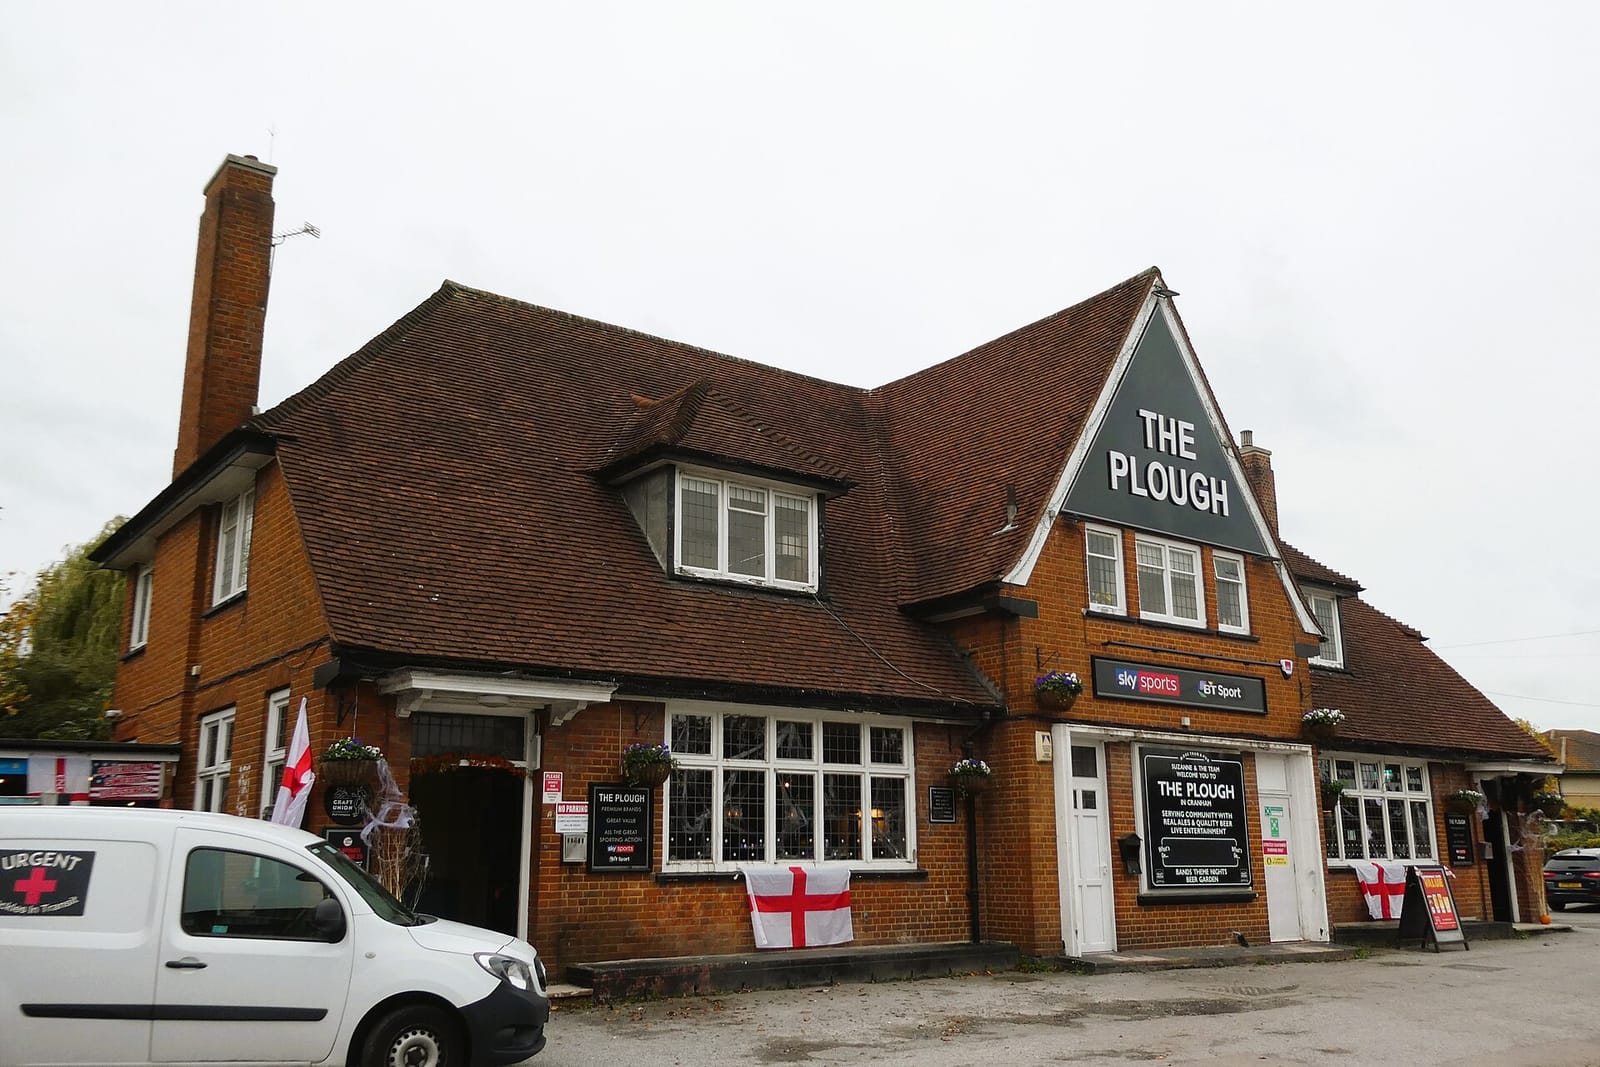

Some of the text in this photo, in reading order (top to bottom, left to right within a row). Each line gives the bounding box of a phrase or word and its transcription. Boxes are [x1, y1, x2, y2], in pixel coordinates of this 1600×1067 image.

[1137, 408, 1197, 461] THE
[1108, 450, 1229, 517] PLOUGH
[1118, 671, 1177, 692] sky sports
[1203, 683, 1241, 699] BT Sport
[1171, 763, 1192, 771] SUZANNE
[1198, 764, 1208, 772] THE
[1208, 765, 1220, 773] TEAM
[1176, 771, 1198, 779] WELCOME
[1157, 780, 1235, 800] THE PLOUGH
[598, 793, 645, 804] THE PLOUGH
[1187, 799, 1212, 807] CRANHAM
[558, 804, 588, 813] NO PARKING
[1161, 810, 1184, 818] SERVING
[1185, 811, 1218, 819] COMMUNITY
[1163, 818, 1177, 826] REAL
[1196, 819, 1219, 828] QUALITY
[1183, 827, 1226, 835] ENTERTAINMENT
[607, 845, 634, 853] sky sports
[1, 851, 83, 871] URGENT
[1175, 868, 1192, 876] BANDS
[40, 896, 80, 913] Transit
